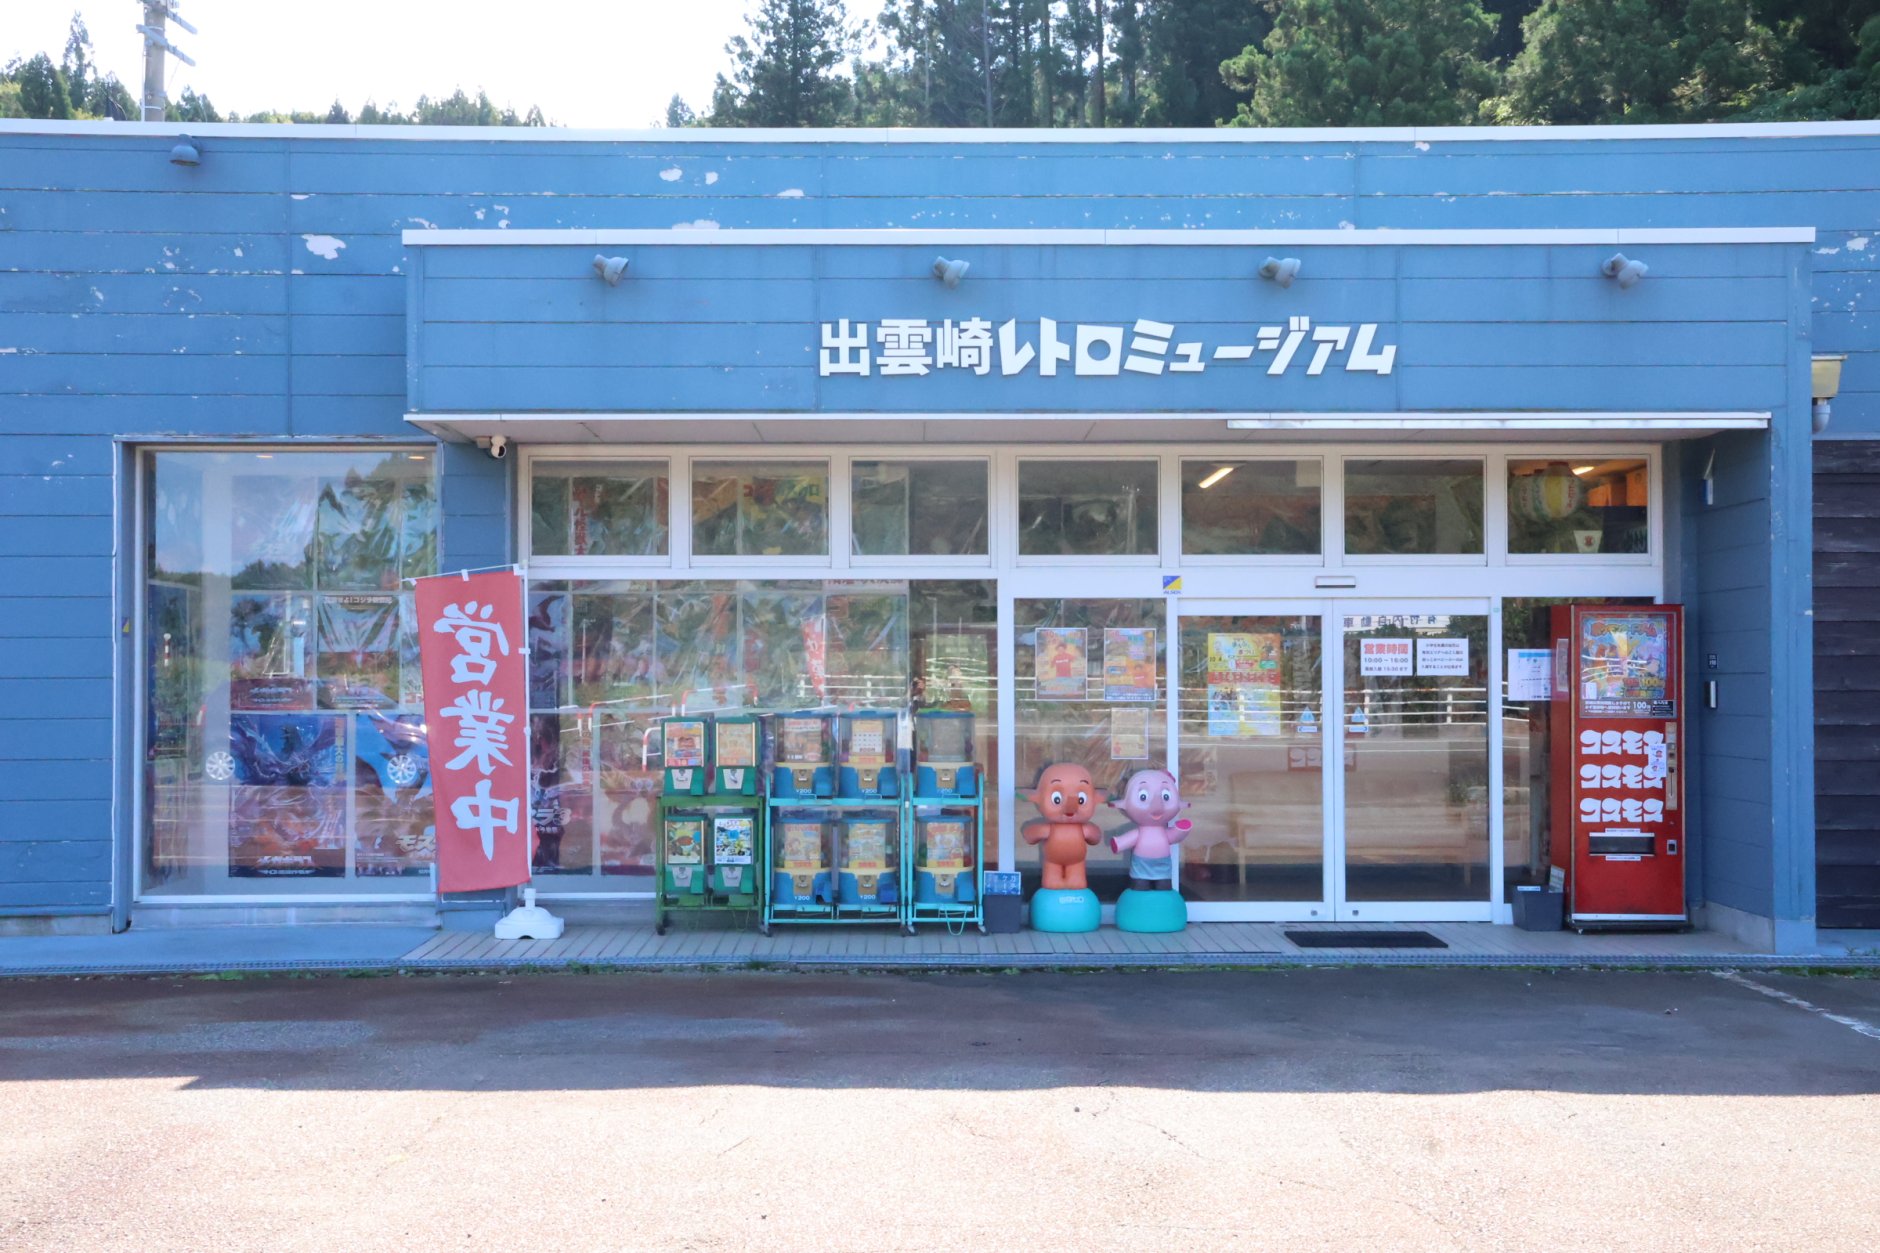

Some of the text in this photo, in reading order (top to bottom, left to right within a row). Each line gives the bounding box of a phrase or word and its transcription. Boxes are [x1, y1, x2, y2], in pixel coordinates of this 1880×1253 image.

[819, 316, 1397, 377] 出雲崎レトロミュージアム
[1364, 643, 1408, 655] 営業時間
[433, 600, 520, 862] 営業中
[1580, 730, 1664, 755] コスモス
[1580, 764, 1663, 788] コスモス
[1580, 797, 1664, 822] コスモス
